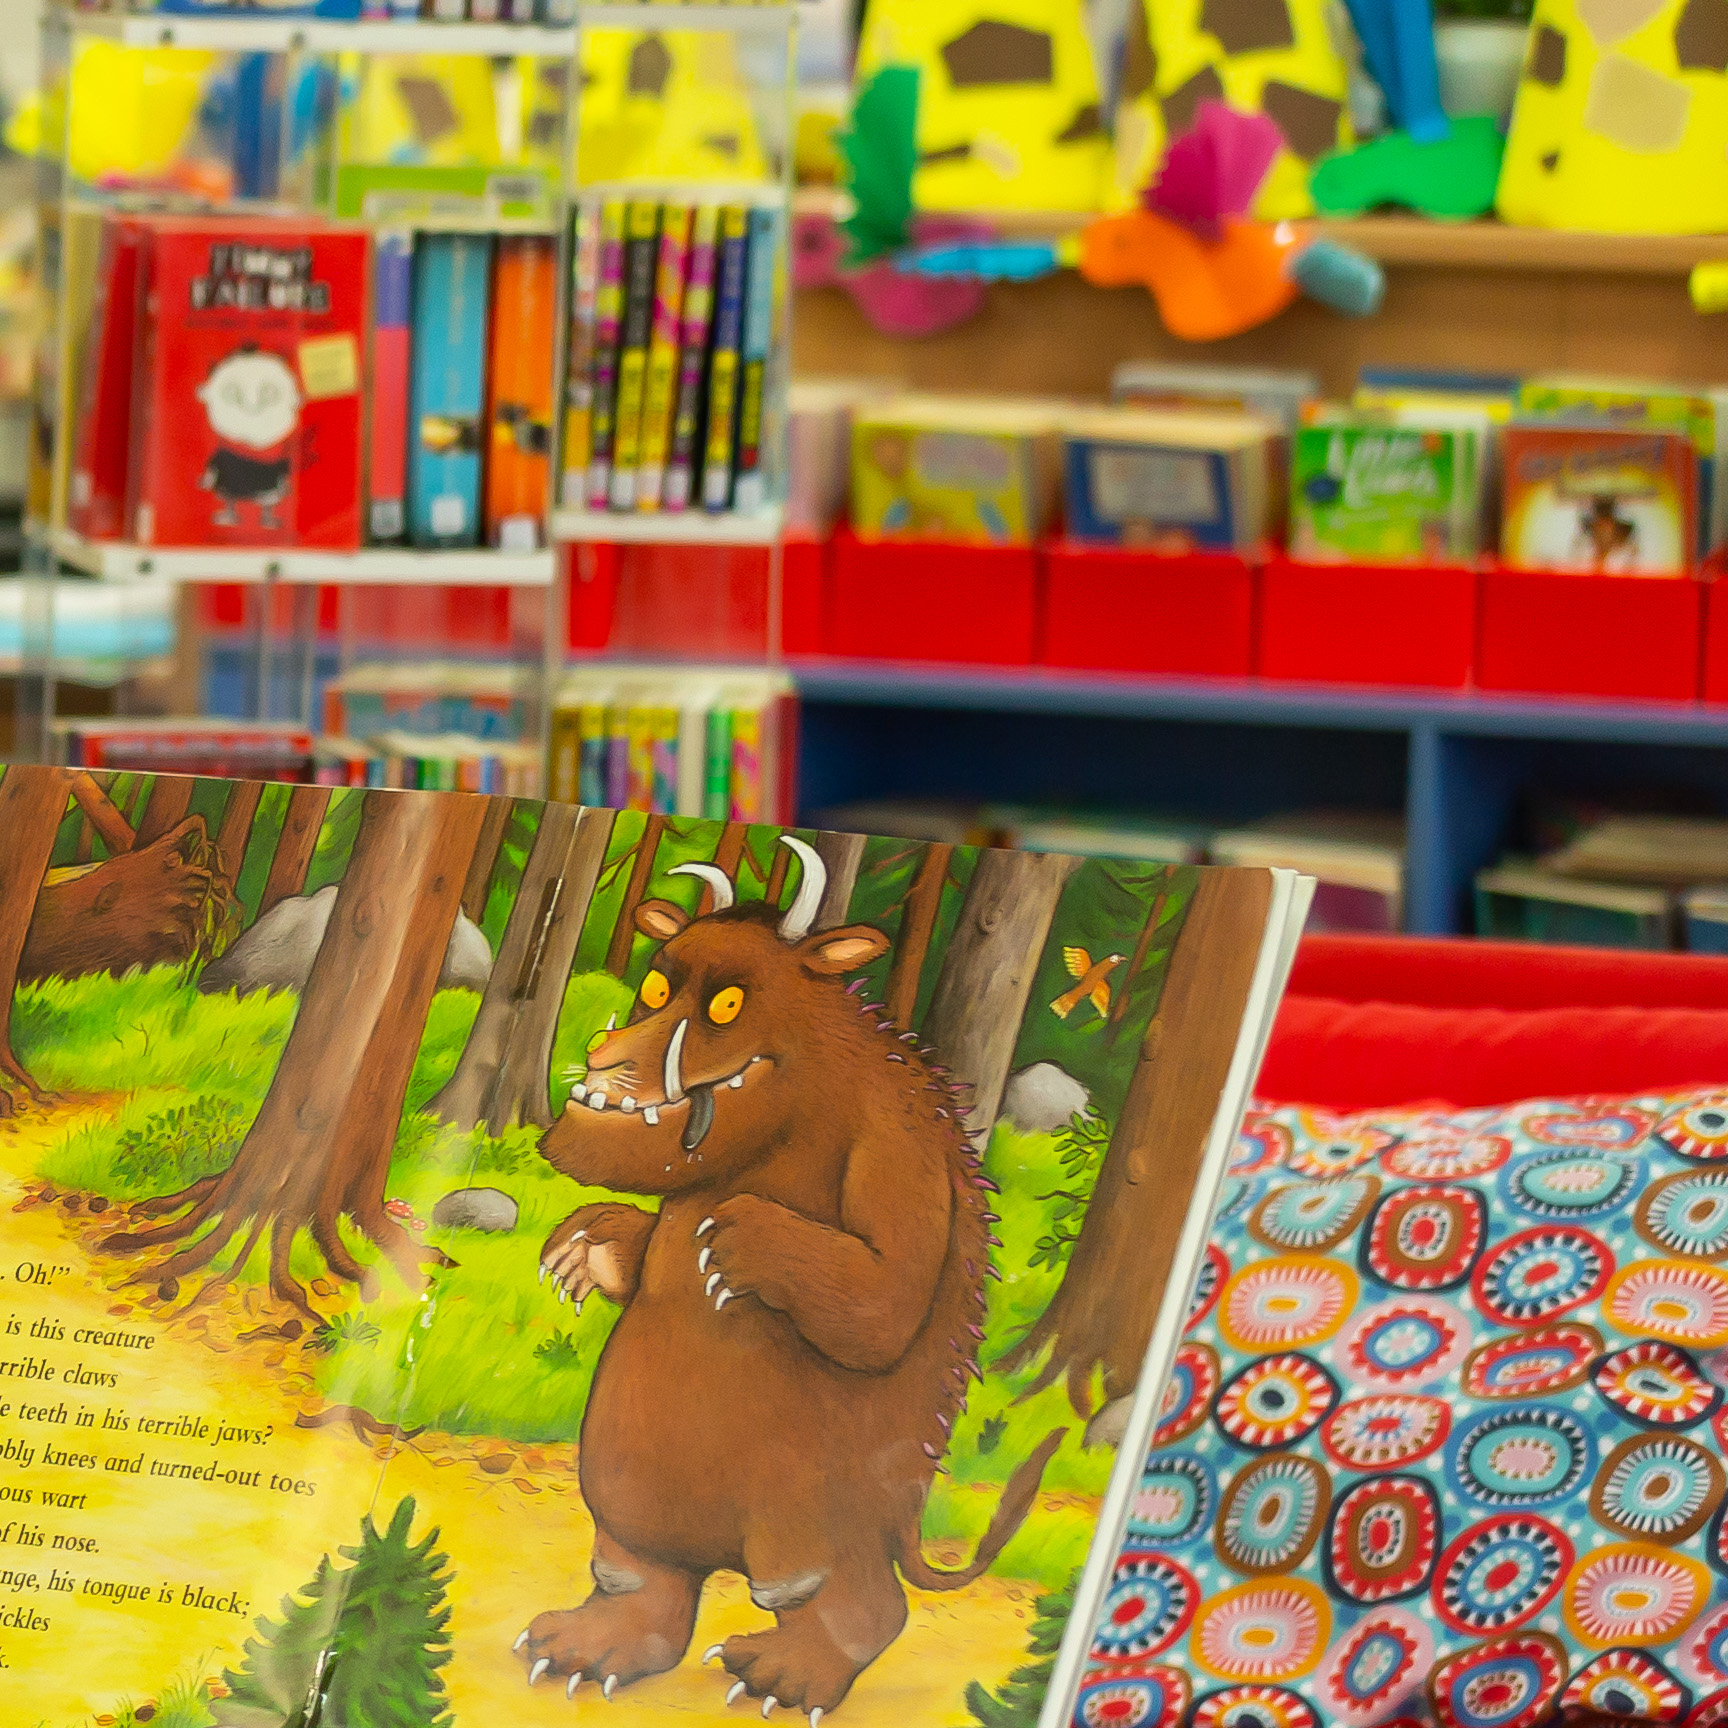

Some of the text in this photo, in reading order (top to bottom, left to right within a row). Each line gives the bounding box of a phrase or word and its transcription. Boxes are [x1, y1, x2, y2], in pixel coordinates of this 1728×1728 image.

[15, 1262, 71, 1286] Oh!”
[5, 1313, 23, 1336] is
[29, 1316, 66, 1341] this
[73, 1328, 155, 1350] creature
[63, 1362, 119, 1388] claws
[18, 1402, 68, 1424] teeth
[74, 1405, 95, 1428] in
[100, 1407, 131, 1431] his
[137, 1415, 209, 1439] terrible
[209, 1419, 273, 1447] jaws?
[41, 1442, 98, 1470] knees
[104, 1452, 145, 1474] and
[150, 1459, 262, 1487] turned-out
[269, 1473, 314, 1495] toes
[42, 1491, 88, 1510] wart
[15, 1523, 46, 1547] his
[51, 1535, 100, 1554] nose.
[46, 1568, 76, 1593] his
[82, 1577, 151, 1605] tongue
[157, 1581, 175, 1604] is
[181, 1583, 250, 1616] black;
